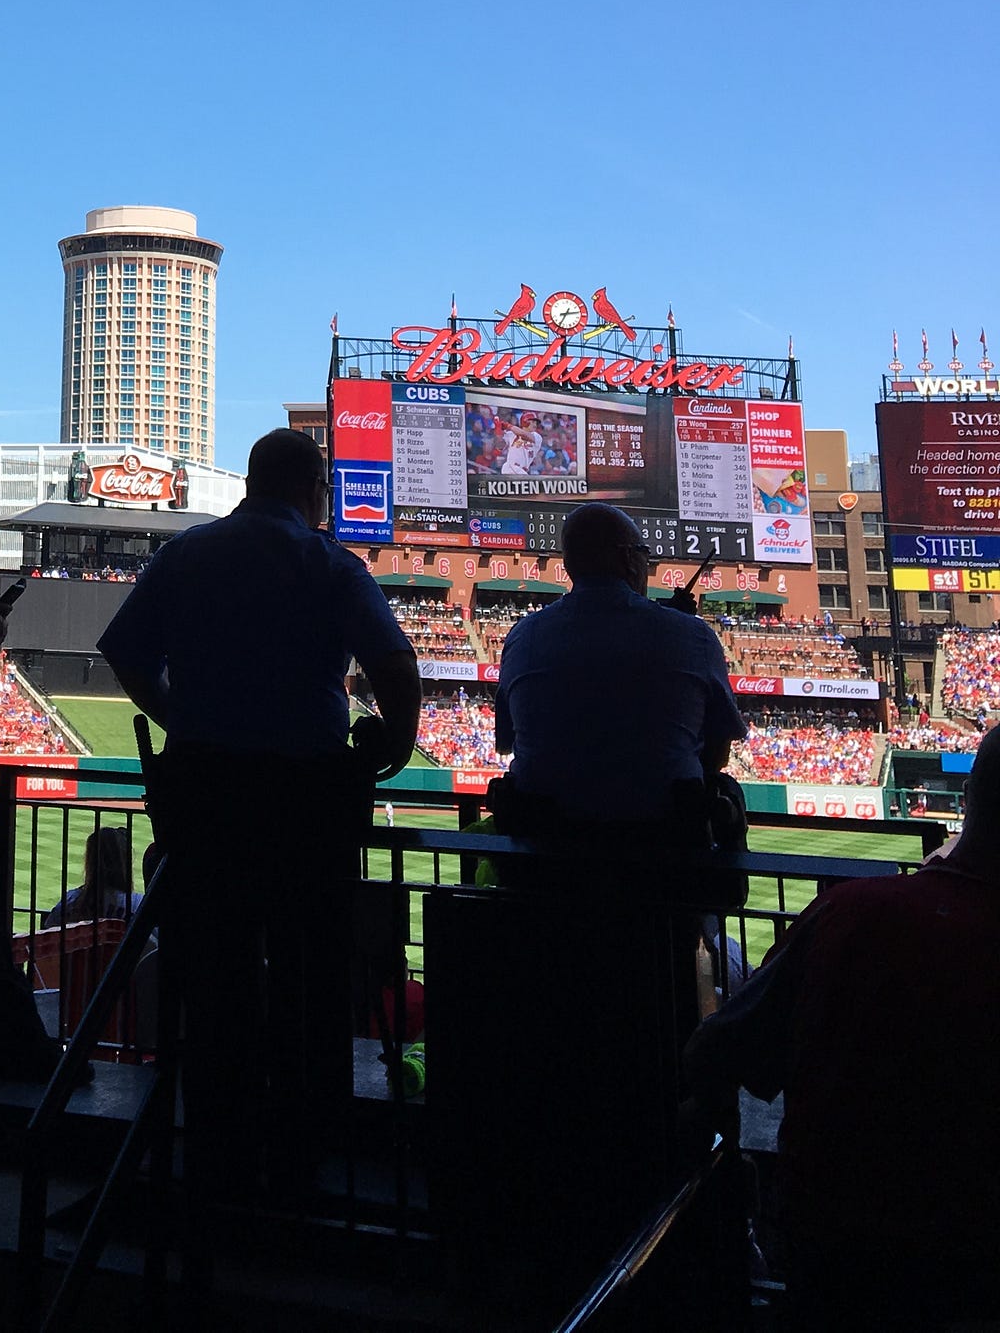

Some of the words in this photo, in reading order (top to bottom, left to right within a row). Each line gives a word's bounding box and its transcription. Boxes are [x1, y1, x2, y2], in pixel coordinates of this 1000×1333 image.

[391, 326, 746, 391] Budweiser
[914, 377, 1000, 396] WORL
[406, 386, 450, 401] CUBS
[406, 406, 440, 414] Schwarber
[688, 399, 733, 416] Cardinals
[336, 410, 389, 430] Coca-Cola
[750, 411, 780, 421] SHOP
[950, 411, 1000, 425] RIVE
[588, 423, 602, 431] FOR
[602, 424, 616, 432] THE
[616, 425, 644, 433] SEASON
[688, 421, 707, 429] Wong
[406, 429, 424, 437] Happ
[751, 428, 793, 438] DINNER
[752, 444, 802, 455] STRETCH.
[917, 449, 964, 461] Headed
[608, 458, 625, 466] .352
[627, 459, 645, 467] .755
[691, 453, 722, 461] Carpenter
[910, 463, 929, 475] the
[932, 463, 985, 475] direction
[100, 468, 167, 496] Coca-Cola
[345, 482, 383, 492] SHELTER
[488, 481, 540, 496] KOLTEN
[540, 480, 588, 495] WONG
[937, 486, 962, 496] Text
[965, 486, 985, 496] the
[953, 498, 966, 508] to
[438, 515, 463, 524] GAME
[964, 510, 995, 519] drive
[378, 528, 391, 536] LIFE
[483, 521, 502, 530] CUBS
[529, 523, 535, 534] 0
[539, 523, 545, 534] 0
[550, 524, 556, 535] 0
[642, 529, 649, 539] 3
[655, 530, 662, 540] 0
[669, 530, 676, 540] 3
[483, 536, 524, 547] CARDINALS
[529, 538, 535, 549] 0
[540, 539, 546, 549] 2
[550, 539, 556, 550] 2
[686, 534, 700, 554] 2
[710, 536, 721, 555] 1
[736, 537, 746, 556] 1
[915, 535, 984, 557] STIFEL
[656, 545, 663, 555] 0
[670, 546, 675, 555] 1
[764, 546, 801, 554] DELIVERS
[392, 555, 399, 574] 1
[412, 557, 425, 575] 2
[438, 557, 450, 577] 6
[464, 558, 476, 577] 9
[490, 560, 508, 579] 10
[522, 561, 540, 580] 14
[661, 568, 685, 588] 42
[699, 570, 723, 590] 45
[736, 572, 759, 591] 85
[933, 570, 959, 586] stl
[436, 665, 474, 676] JEWELERS
[736, 677, 777, 693] Coca-Cola
[819, 684, 869, 695] ITDroll.com
[456, 772, 486, 785] Bank
[26, 779, 44, 791] FOR
[46, 780, 67, 791] YOU.
[797, 802, 812, 813] 66
[826, 804, 842, 814] 66
[856, 805, 872, 815] 66
